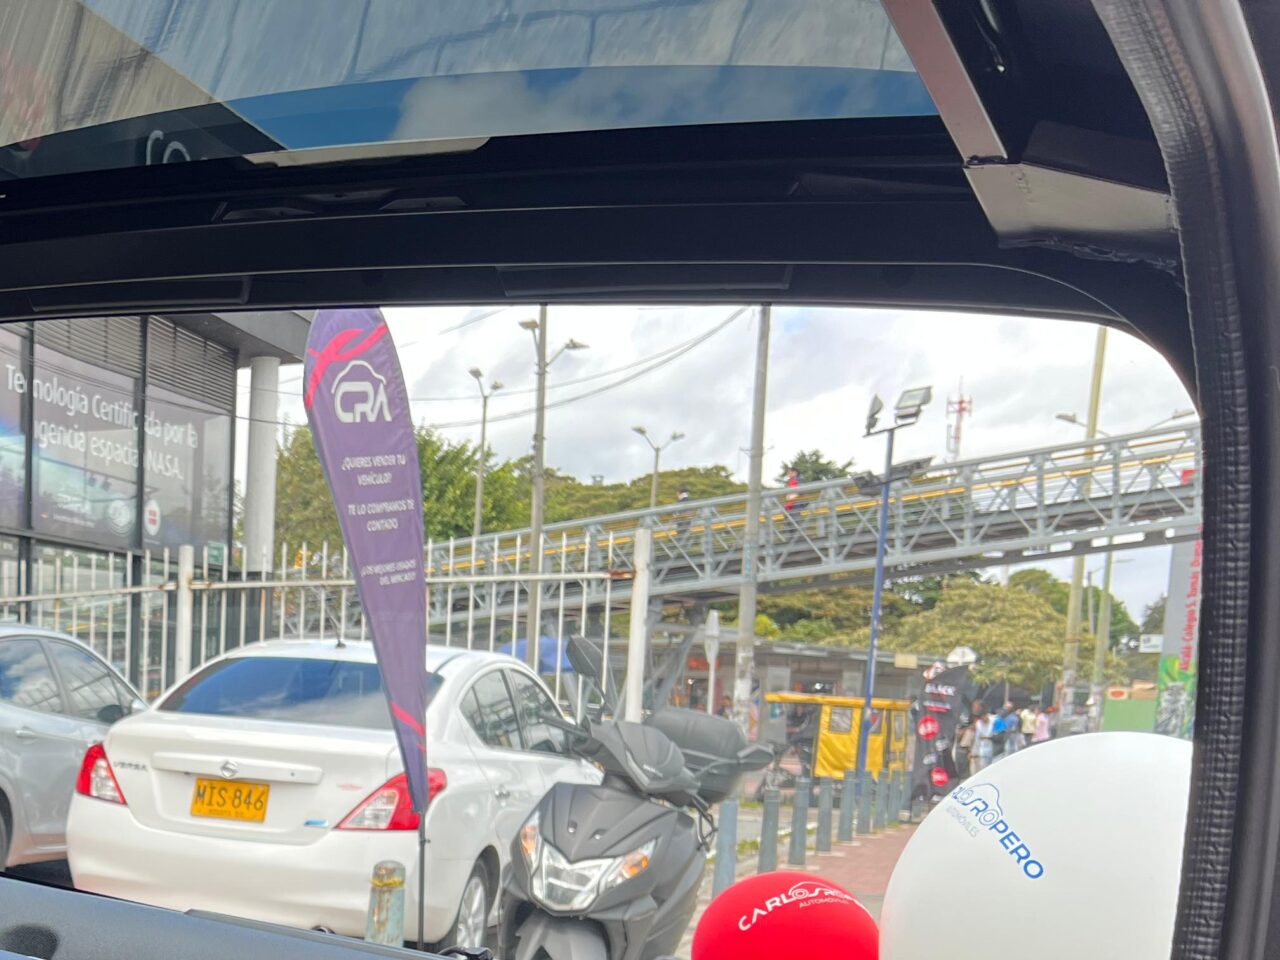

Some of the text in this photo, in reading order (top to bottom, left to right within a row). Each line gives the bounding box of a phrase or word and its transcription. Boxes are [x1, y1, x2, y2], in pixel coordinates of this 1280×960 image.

[5, 364, 89, 416] Tenología
[92, 394, 162, 438] Certificda
[90, 436, 139, 468] espacia
[195, 783, 266, 812] MIS 846
